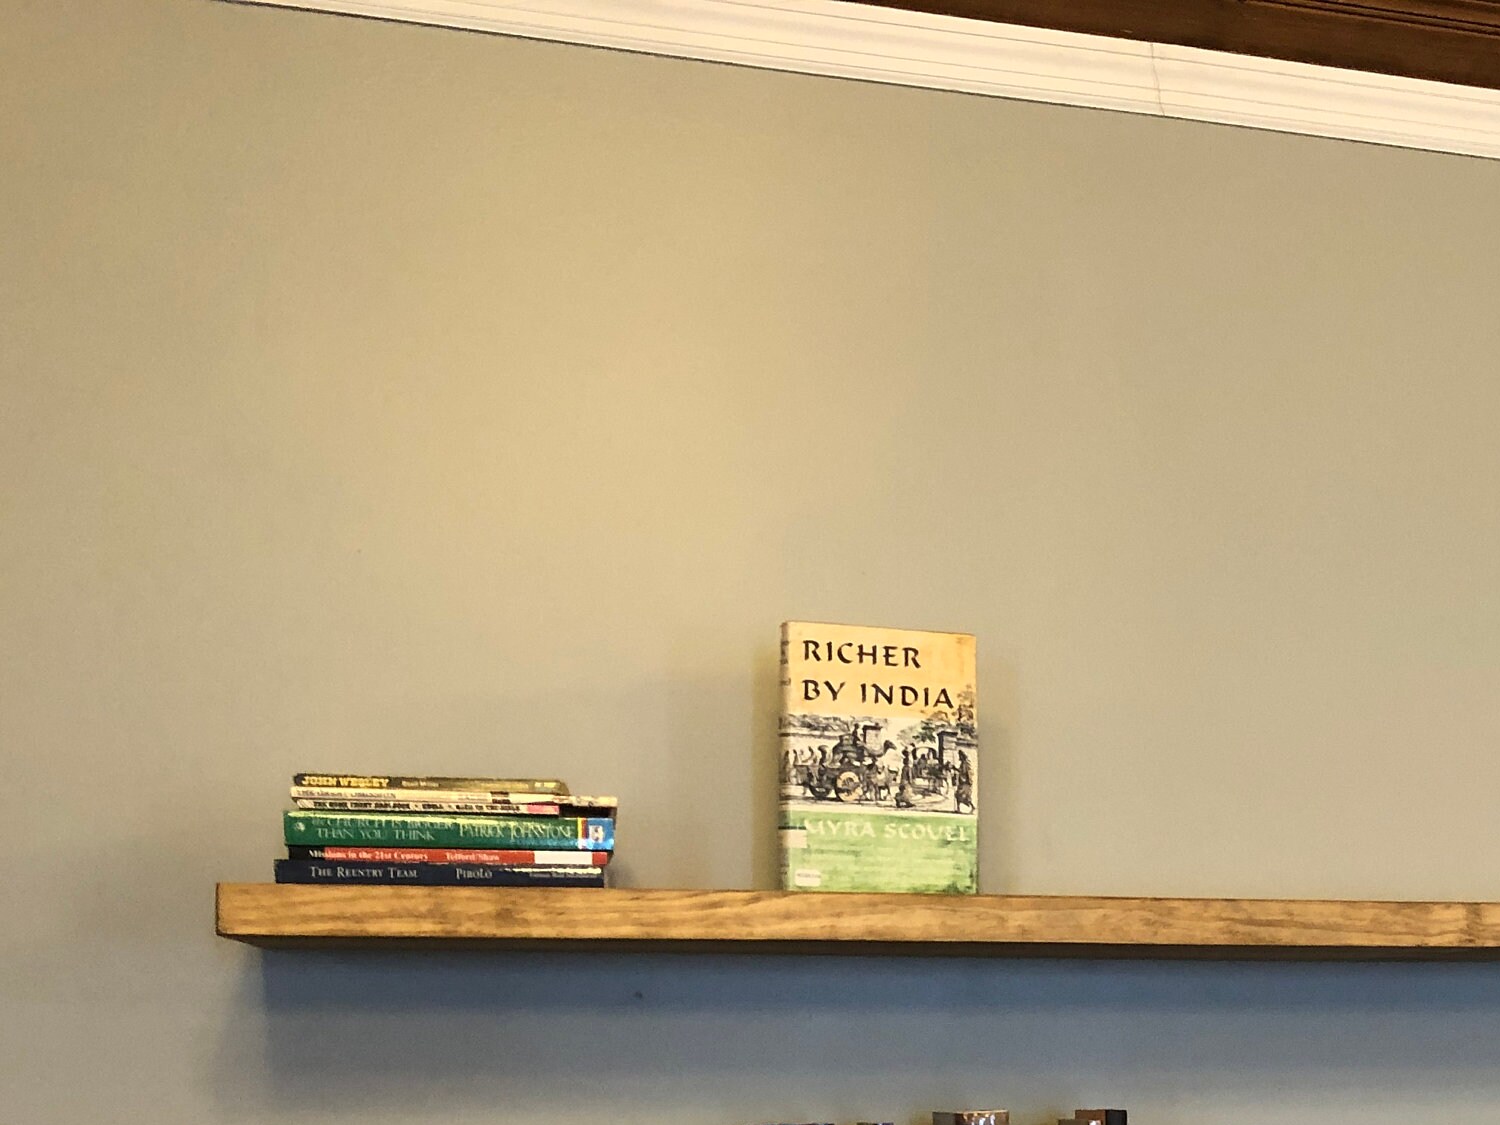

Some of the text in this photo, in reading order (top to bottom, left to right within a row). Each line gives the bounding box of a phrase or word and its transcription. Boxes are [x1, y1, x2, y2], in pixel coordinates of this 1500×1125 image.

[803, 640, 921, 669] RICHER
[802, 679, 954, 709] BY INDIA
[302, 776, 390, 788] JOHN WESLEY
[318, 828, 435, 841] THAN YOU THINK
[459, 821, 575, 842] PATRICK JOHNSTONE
[805, 819, 876, 838] MYRA
[310, 866, 332, 877] THE
[388, 867, 418, 878] TEAM
